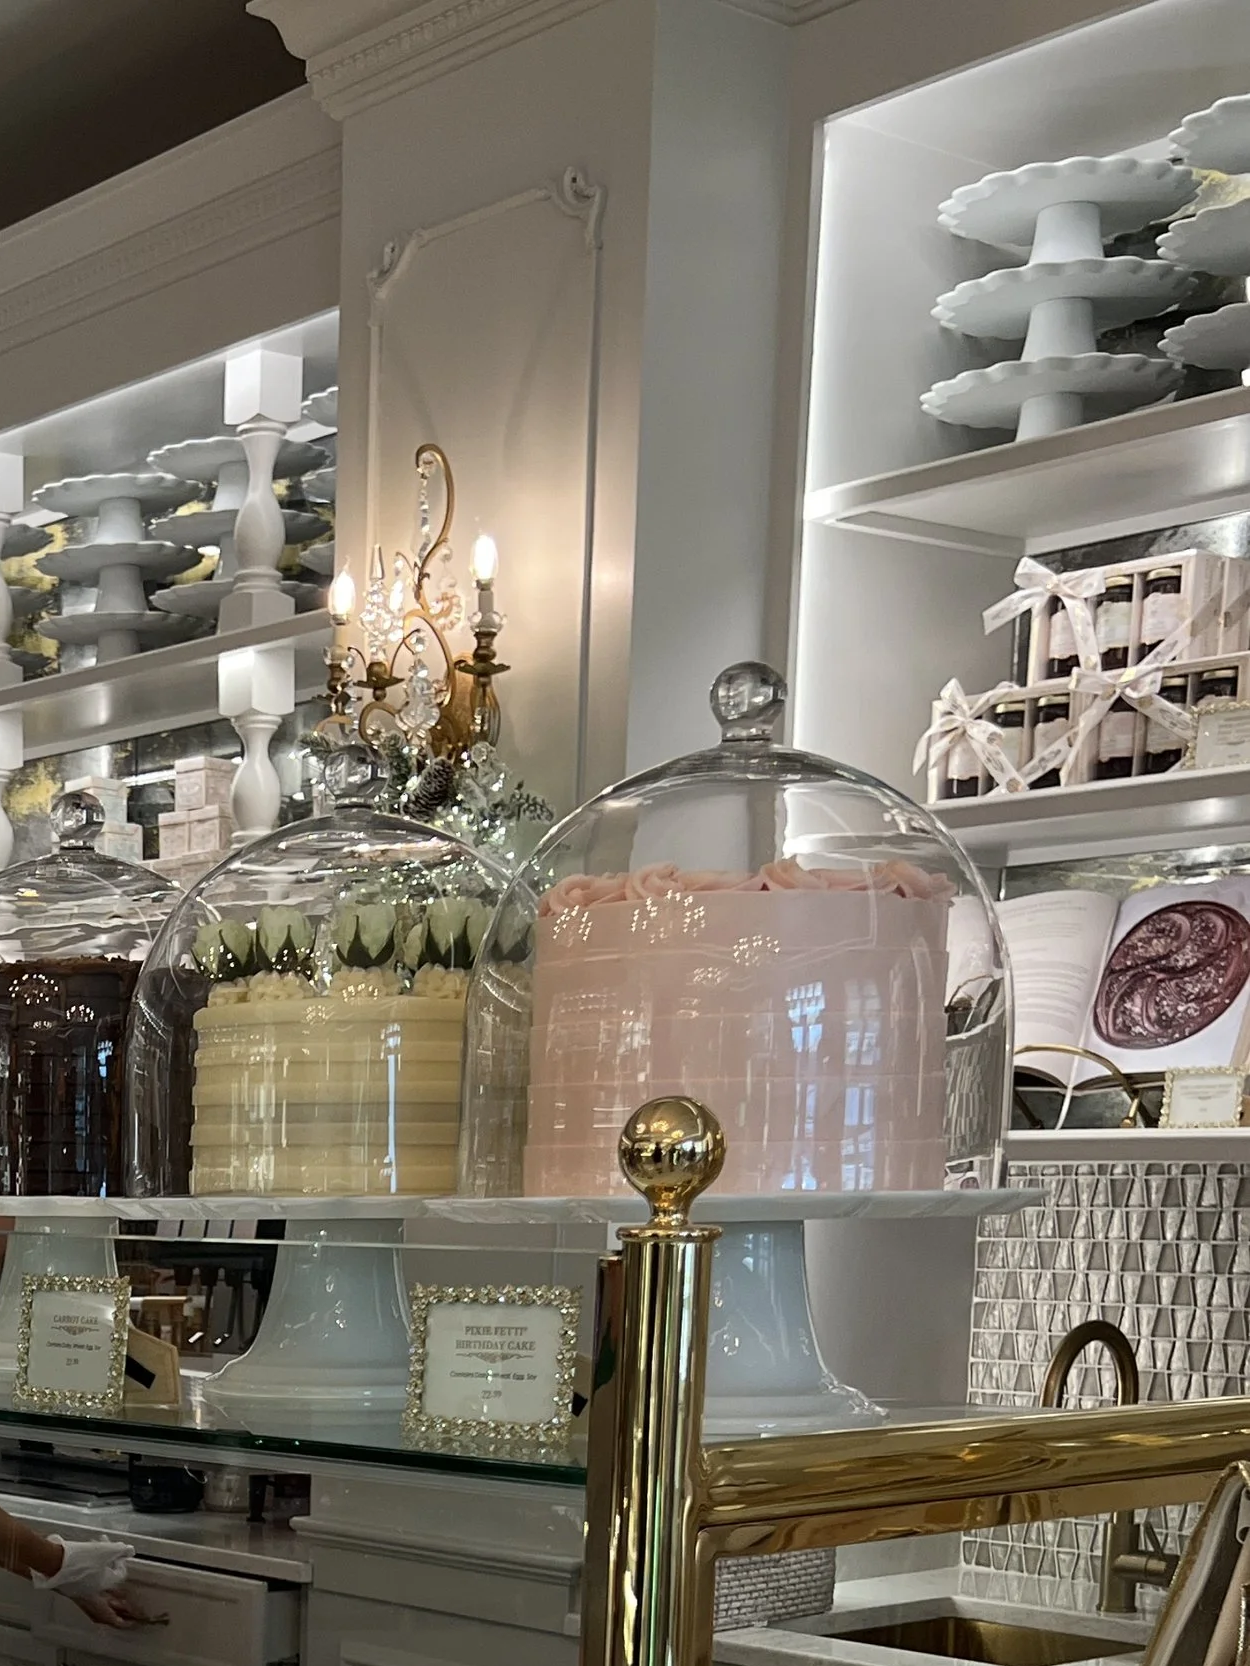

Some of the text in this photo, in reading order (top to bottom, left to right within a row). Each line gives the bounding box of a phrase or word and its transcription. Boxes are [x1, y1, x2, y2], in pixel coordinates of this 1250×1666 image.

[465, 1326, 492, 1335] PIXIE
[455, 1340, 536, 1351] BIRTHDAY CAKE
